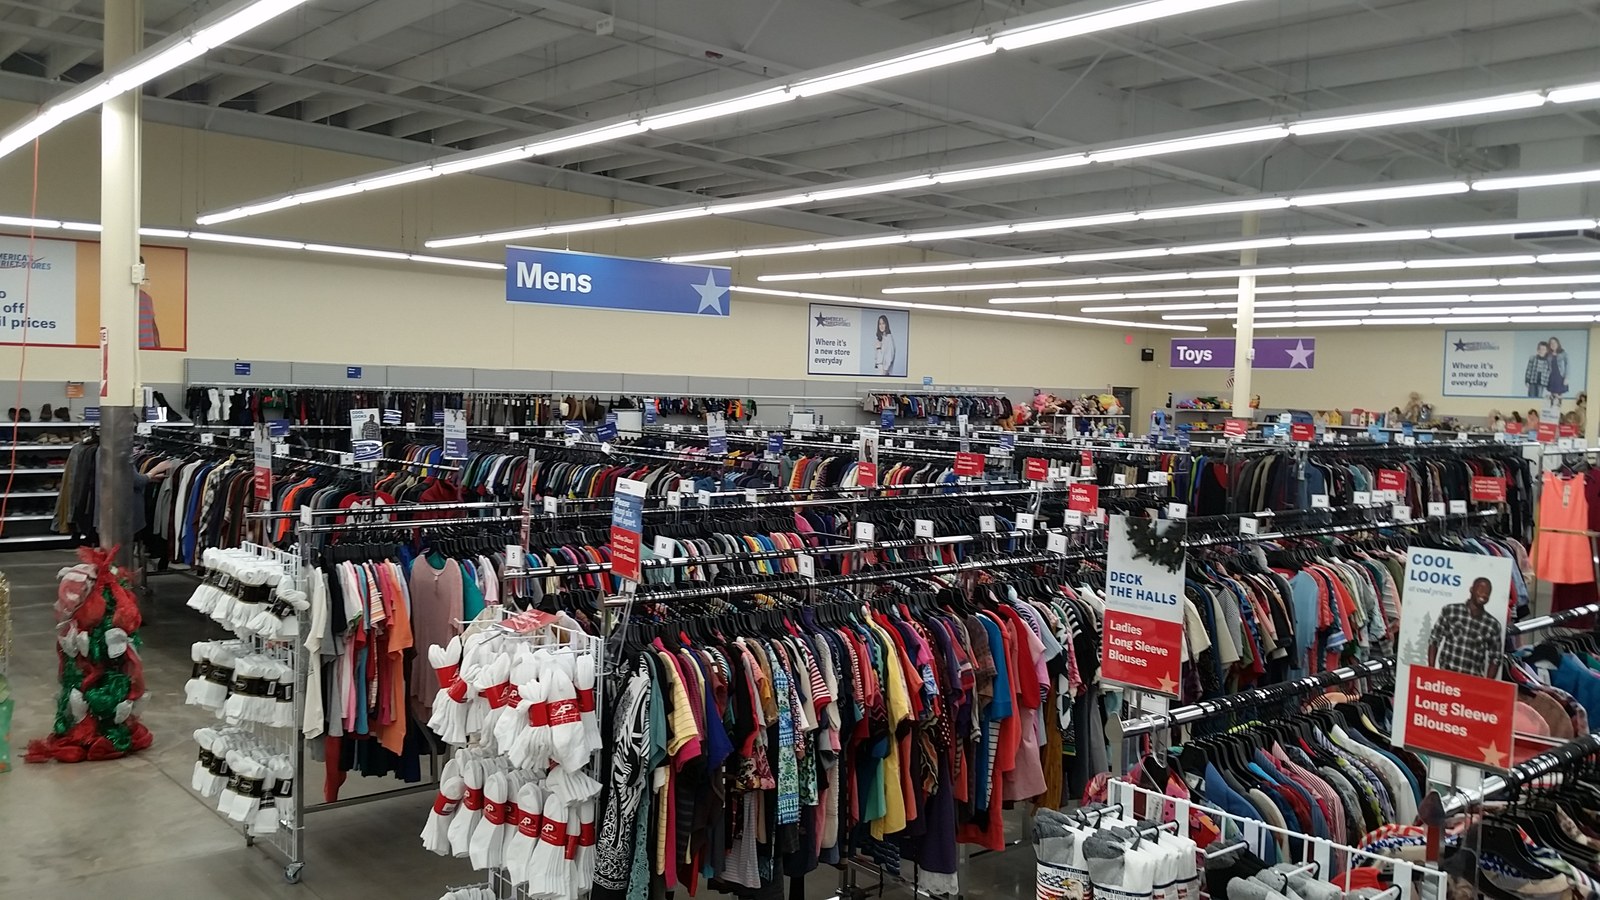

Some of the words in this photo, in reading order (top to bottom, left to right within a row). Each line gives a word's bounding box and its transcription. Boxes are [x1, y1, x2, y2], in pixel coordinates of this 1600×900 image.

[516, 261, 592, 294] Mens
[3, 302, 25, 314] off
[11, 317, 56, 330] prices
[815, 338, 835, 347] Where
[814, 357, 842, 366] everyday
[1176, 346, 1212, 364] Toys
[614, 497, 630, 508] Please
[1072, 494, 1090, 502] T-Shirts
[1412, 553, 1454, 569] COOL
[1110, 571, 1143, 586] DECK
[1410, 569, 1462, 587] LOOKS
[1110, 585, 1132, 599] THE
[1136, 589, 1177, 605] HALLS
[1110, 620, 1142, 636] Ladies
[1109, 635, 1133, 651] Long
[1135, 640, 1168, 656] Sleeve
[1108, 649, 1147, 667] Blouses
[1416, 676, 1461, 697] Ladies
[555, 704, 574, 716] AP
[1415, 695, 1448, 716] Long
[1450, 702, 1498, 725] Sleeve
[1413, 713, 1468, 737] Blouses
[520, 817, 531, 826] AP
[542, 823, 553, 832] AP
